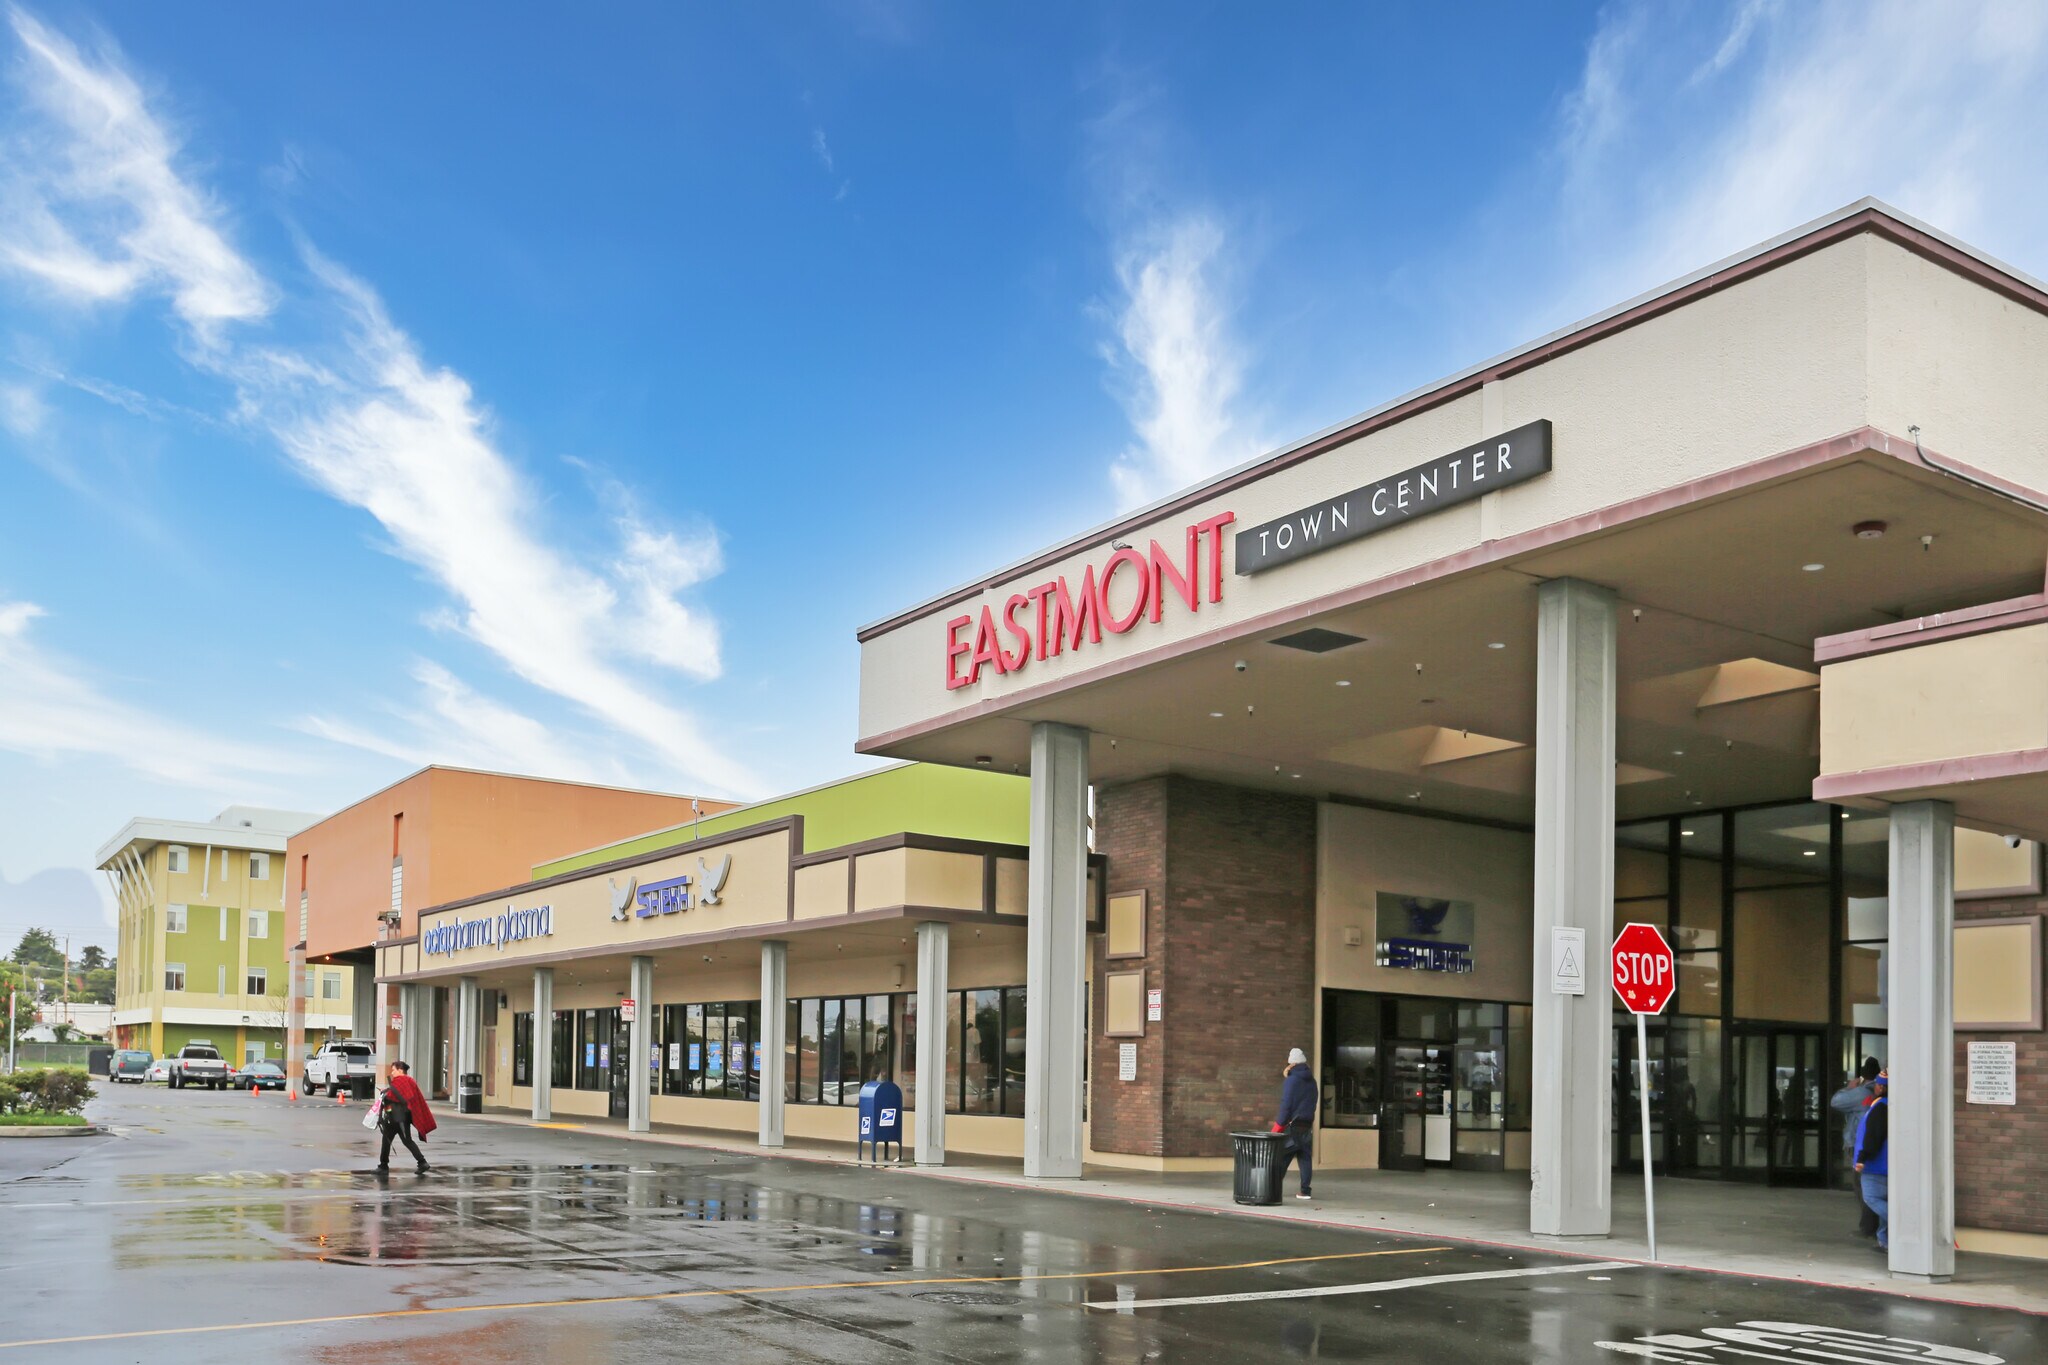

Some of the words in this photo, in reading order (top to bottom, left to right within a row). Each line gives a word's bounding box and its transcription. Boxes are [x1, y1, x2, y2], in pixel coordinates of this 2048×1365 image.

[1259, 501, 1348, 556] TOWN
[1371, 443, 1512, 516] CENTER
[946, 511, 1235, 691] EASTMONT
[424, 917, 495, 958] octapharma
[497, 905, 553, 951] plasma
[1616, 951, 1669, 986] STOP
[1593, 1320, 2006, 1365] TOP
